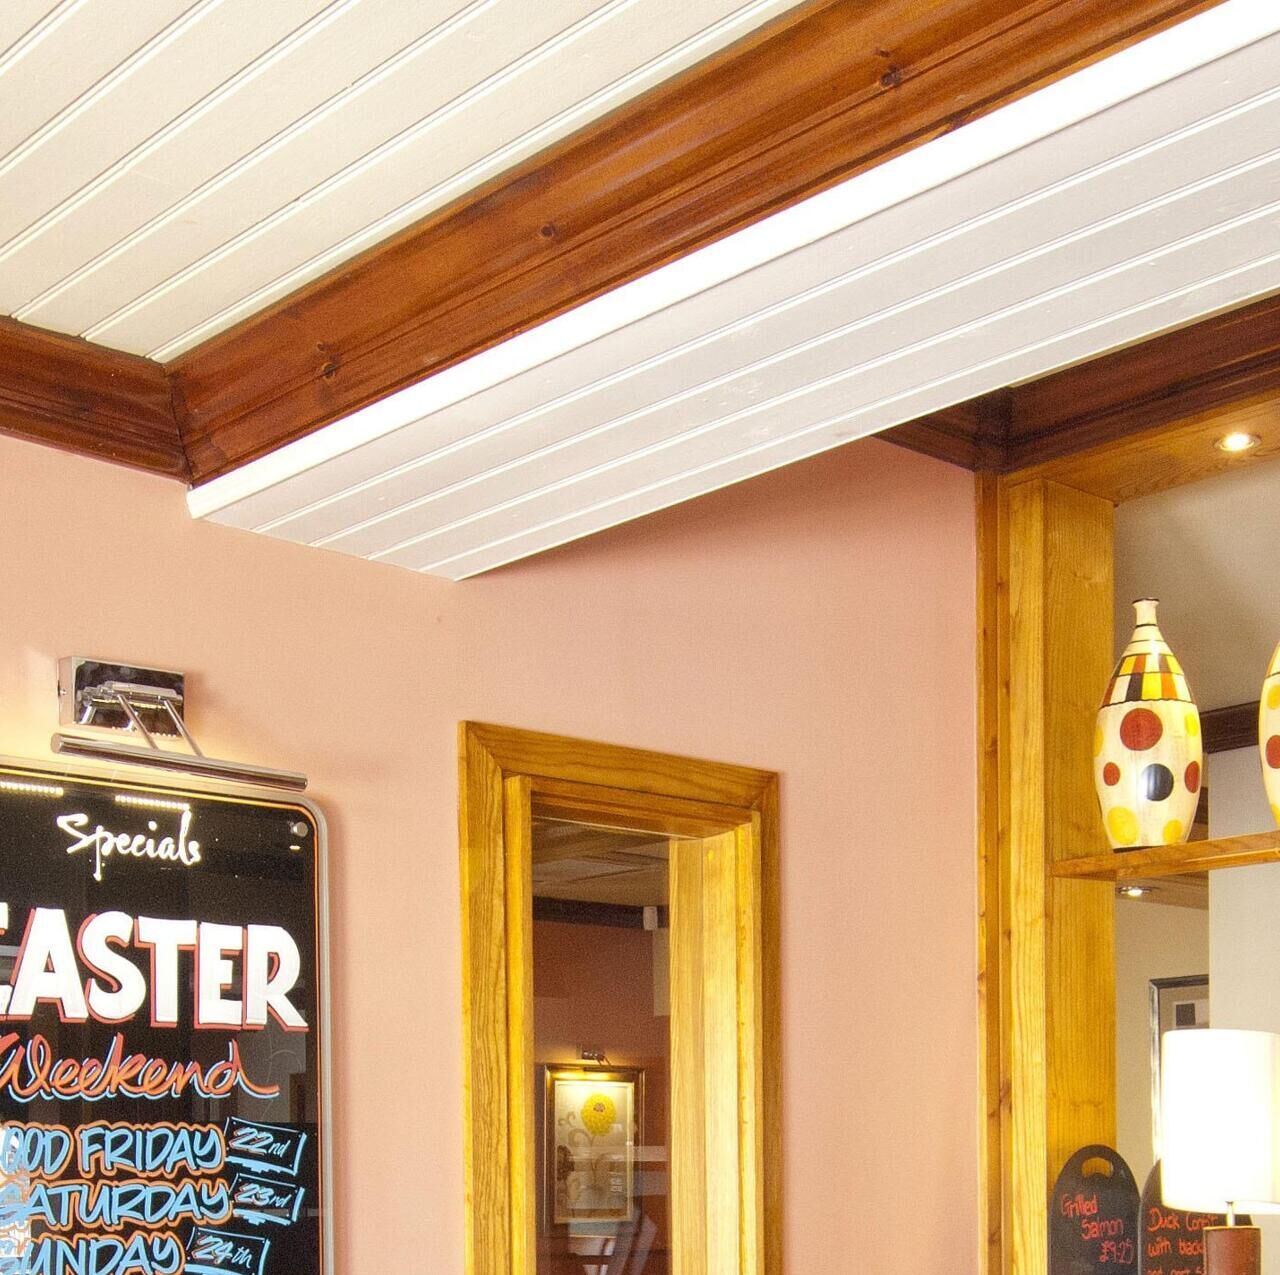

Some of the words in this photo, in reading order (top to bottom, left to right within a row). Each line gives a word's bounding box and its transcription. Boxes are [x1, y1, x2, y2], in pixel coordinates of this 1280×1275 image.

[57, 808, 201, 881] Specials
[77, 1123, 223, 1176] FRIDAY
[229, 1127, 289, 1158] 22nd
[234, 1182, 289, 1208] 23rd
[1147, 1207, 1180, 1232] Duck
[191, 1235, 251, 1269] 24th
